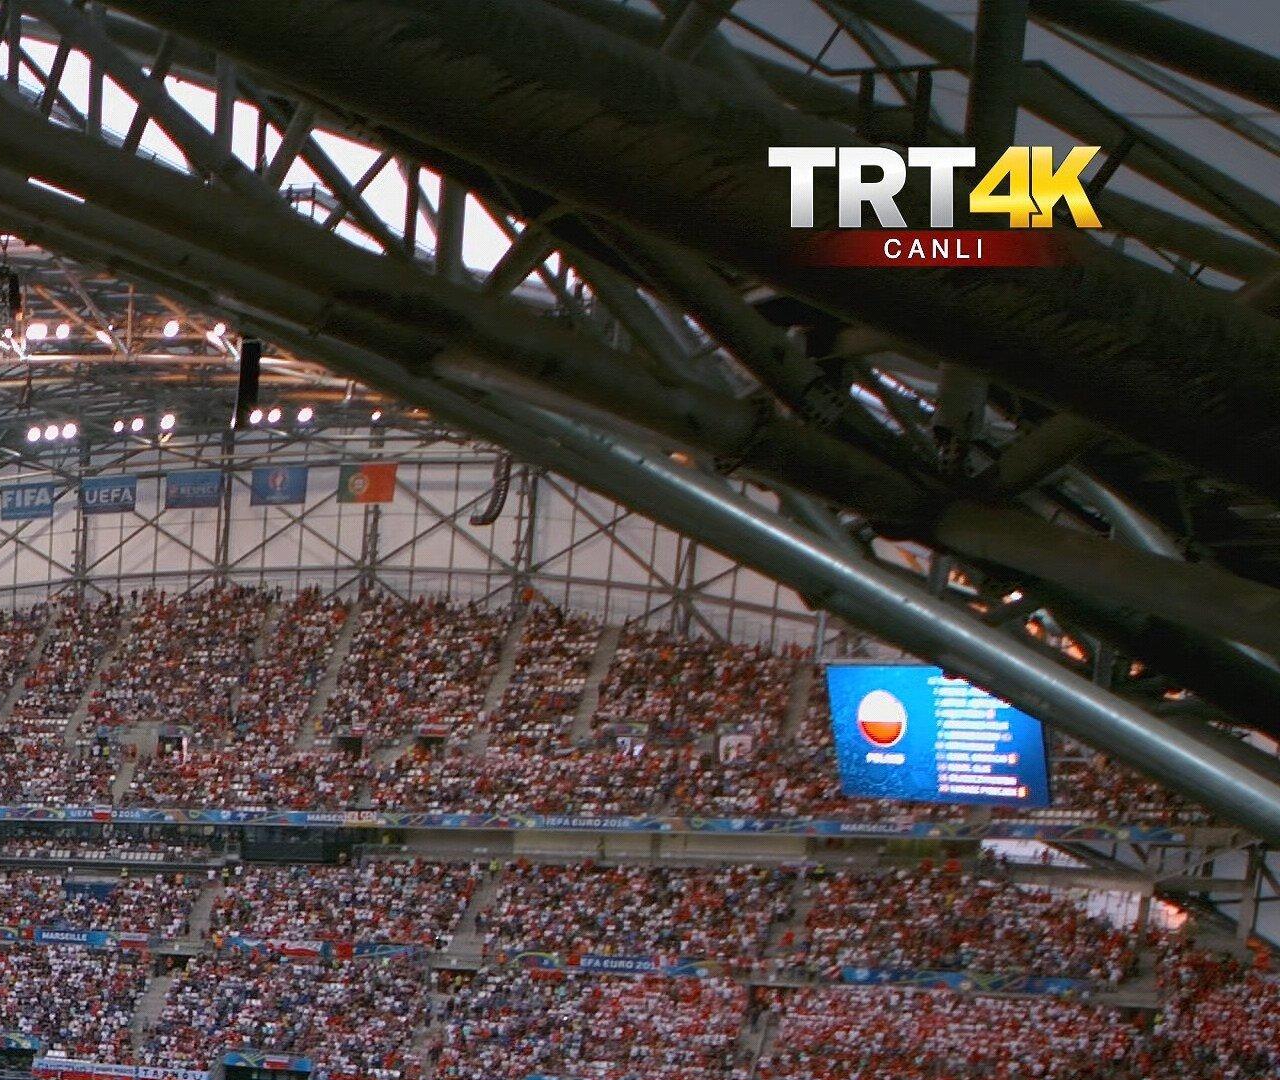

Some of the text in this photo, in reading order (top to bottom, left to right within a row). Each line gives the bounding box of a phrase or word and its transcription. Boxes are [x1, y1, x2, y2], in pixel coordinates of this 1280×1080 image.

[2, 489, 52, 508] FIFA
[85, 487, 132, 505] UEFA
[42, 931, 87, 942] MARSEILLE
[603, 960, 633, 969] EURO
